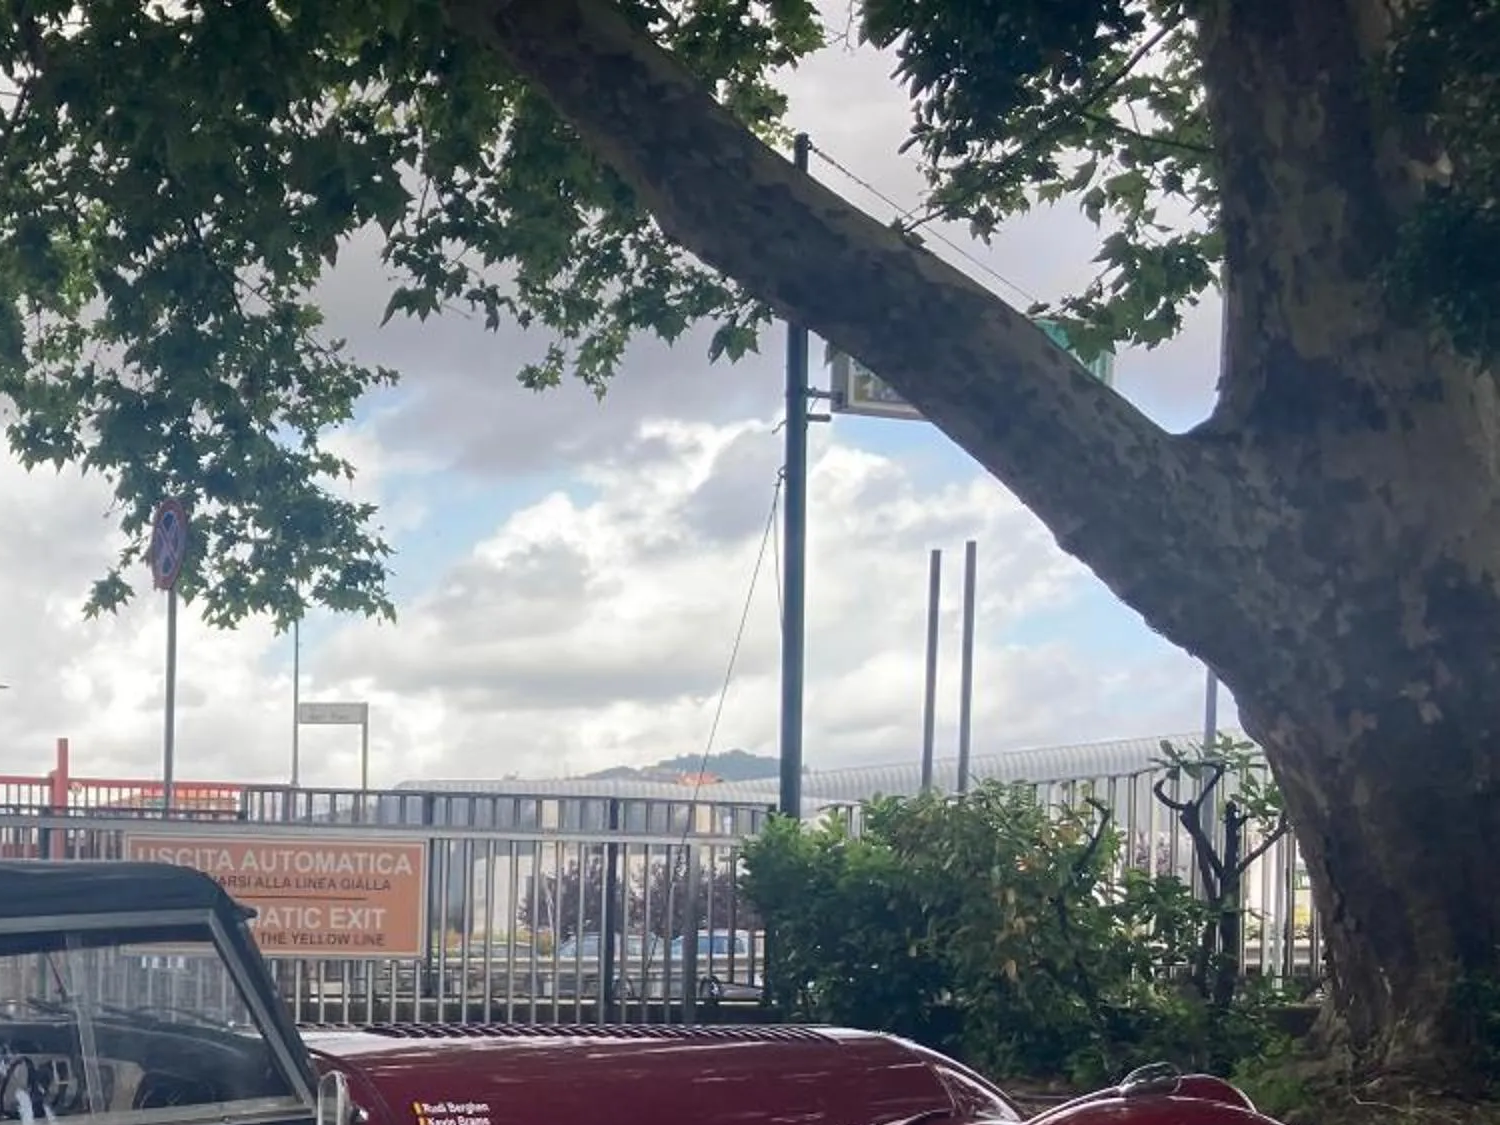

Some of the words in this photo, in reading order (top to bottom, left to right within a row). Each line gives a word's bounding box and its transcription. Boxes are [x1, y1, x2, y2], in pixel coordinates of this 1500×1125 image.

[136, 847, 234, 871] USCITA
[240, 849, 413, 876] AUTOMATICA
[214, 875, 252, 888] ARSI
[255, 876, 293, 889] ALLA
[295, 877, 337, 891] LINEA
[340, 878, 392, 891] GIALLA
[329, 907, 387, 930] EXIT
[260, 931, 288, 945] THE
[291, 931, 351, 945] YELLOW
[353, 933, 387, 947] LINE
